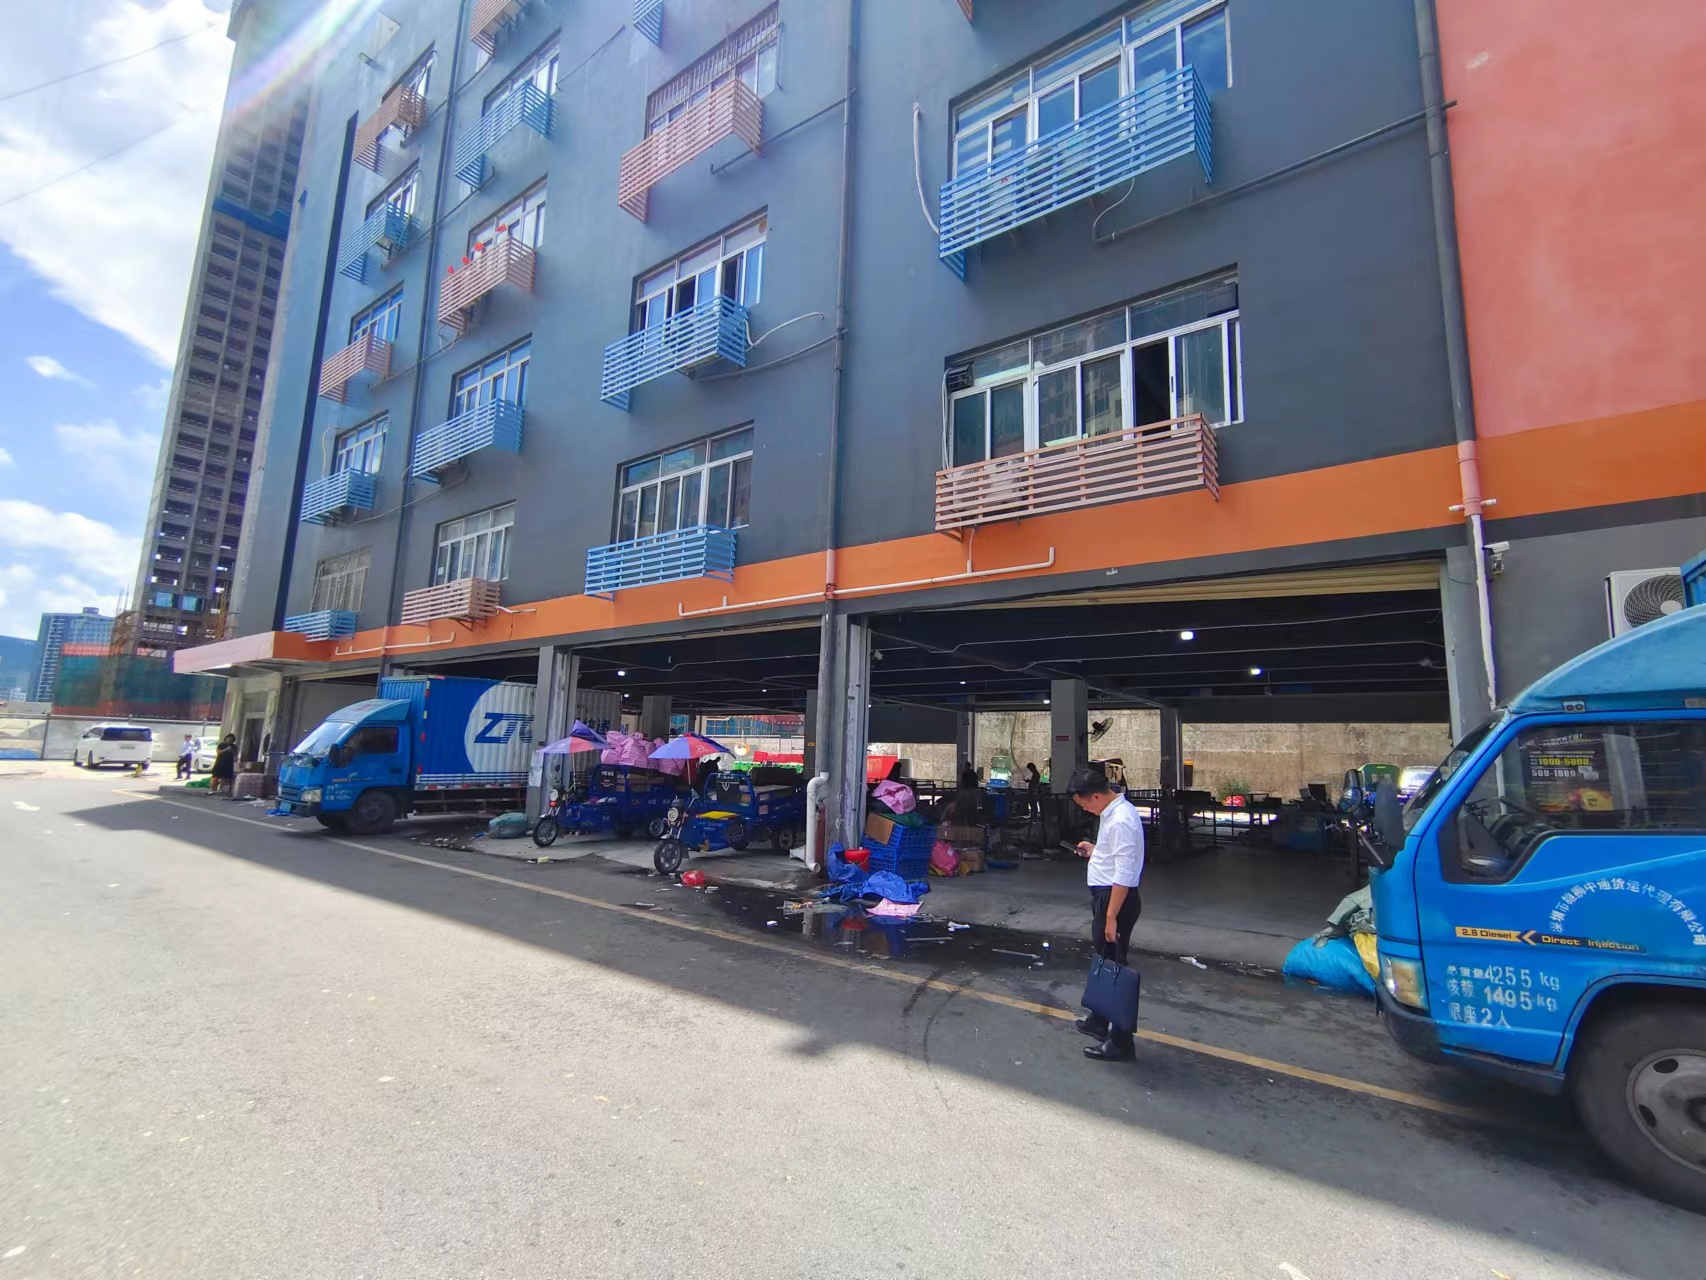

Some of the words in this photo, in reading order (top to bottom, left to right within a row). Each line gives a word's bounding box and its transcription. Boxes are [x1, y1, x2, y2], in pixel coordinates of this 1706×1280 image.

[1462, 928, 1477, 937] 2.8
[1480, 930, 1512, 939] Diesel
[1541, 935, 1580, 946] Direct
[1588, 938, 1640, 951] Injection
[1539, 971, 1560, 991] kg
[1483, 985, 1533, 1011] 1495
[1536, 993, 1558, 1012] kg
